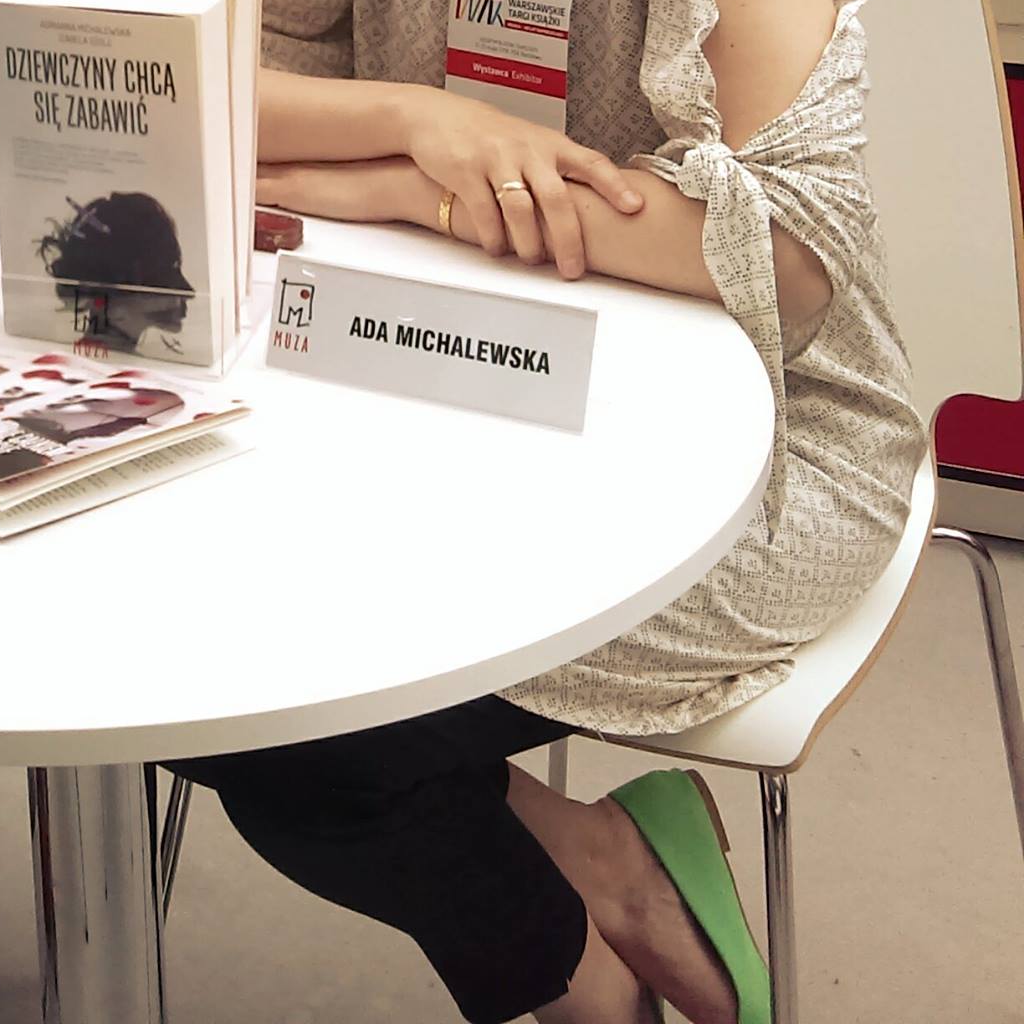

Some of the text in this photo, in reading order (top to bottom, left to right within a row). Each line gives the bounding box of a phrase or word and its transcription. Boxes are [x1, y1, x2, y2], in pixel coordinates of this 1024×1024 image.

[507, 9, 561, 27] TARGI KSIĄŻKI
[5, 46, 177, 104] DZIEWCZYNY CHCĄ
[472, 62, 543, 85] Wystawca Exhibitor
[33, 90, 149, 136] SIĘ ZABAWIĆ
[273, 330, 310, 354] MUZA
[349, 315, 551, 376] ADA MICHALEWSKA
